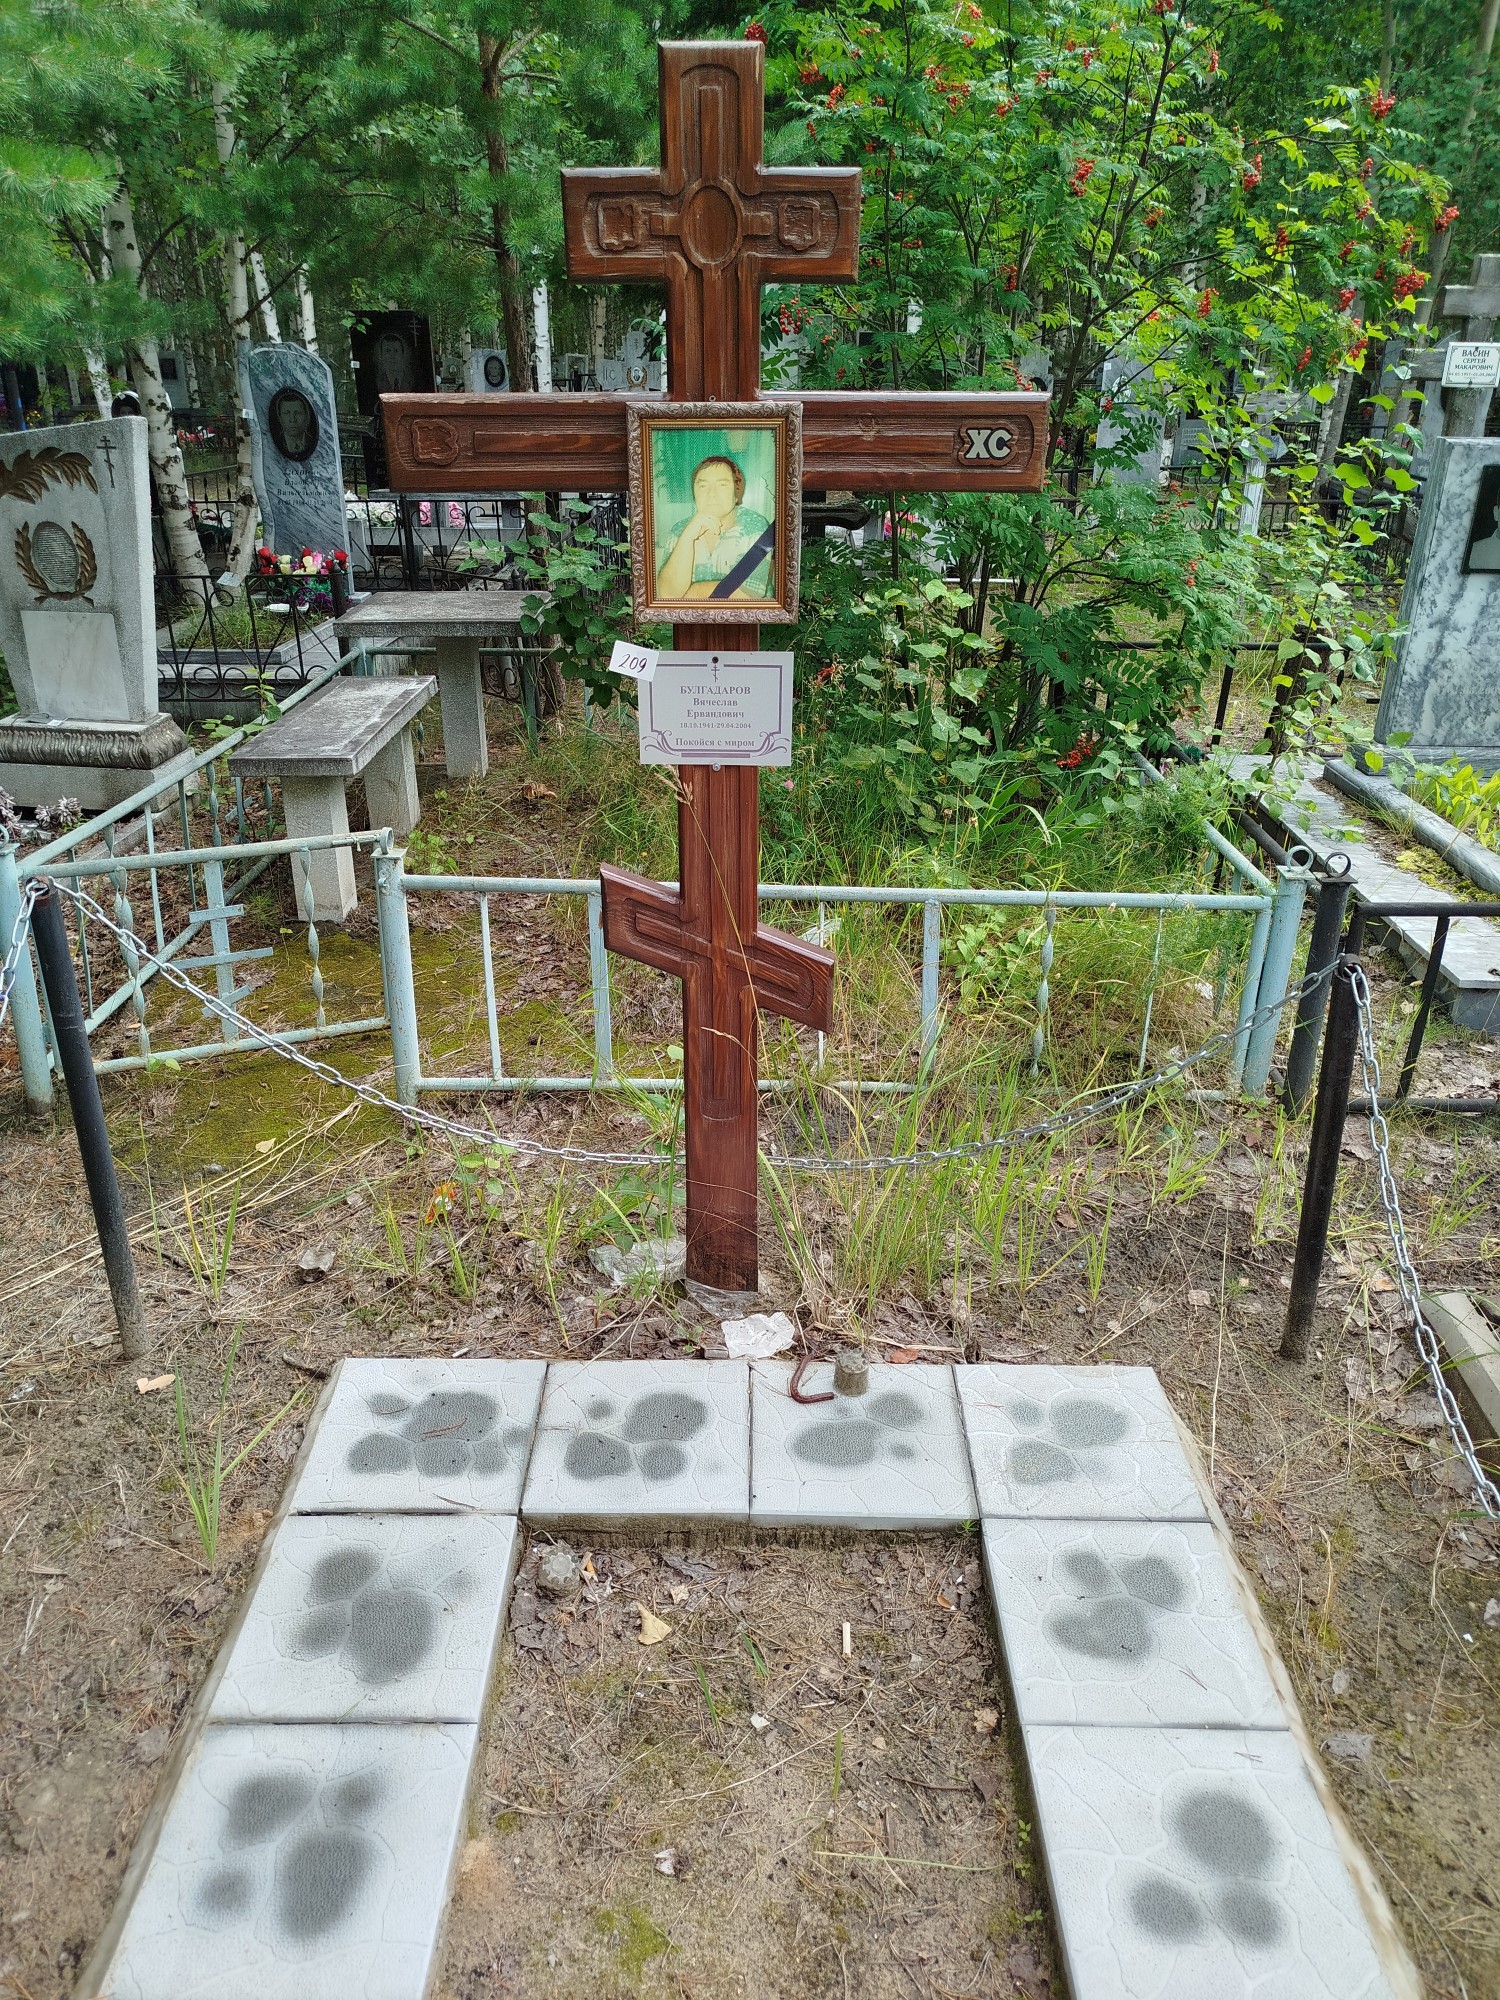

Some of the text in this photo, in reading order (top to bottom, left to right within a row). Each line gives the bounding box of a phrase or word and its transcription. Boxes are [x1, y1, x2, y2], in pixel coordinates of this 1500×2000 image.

[965, 429, 1013, 459] ХС
[618, 653, 648, 673] 209
[680, 685, 751, 695] БУЛГАДАРОВ
[693, 697, 738, 706] Вячеслав
[687, 709, 744, 719] Ервандович
[675, 737, 715, 746] Покойся
[724, 740, 755, 748] миром
